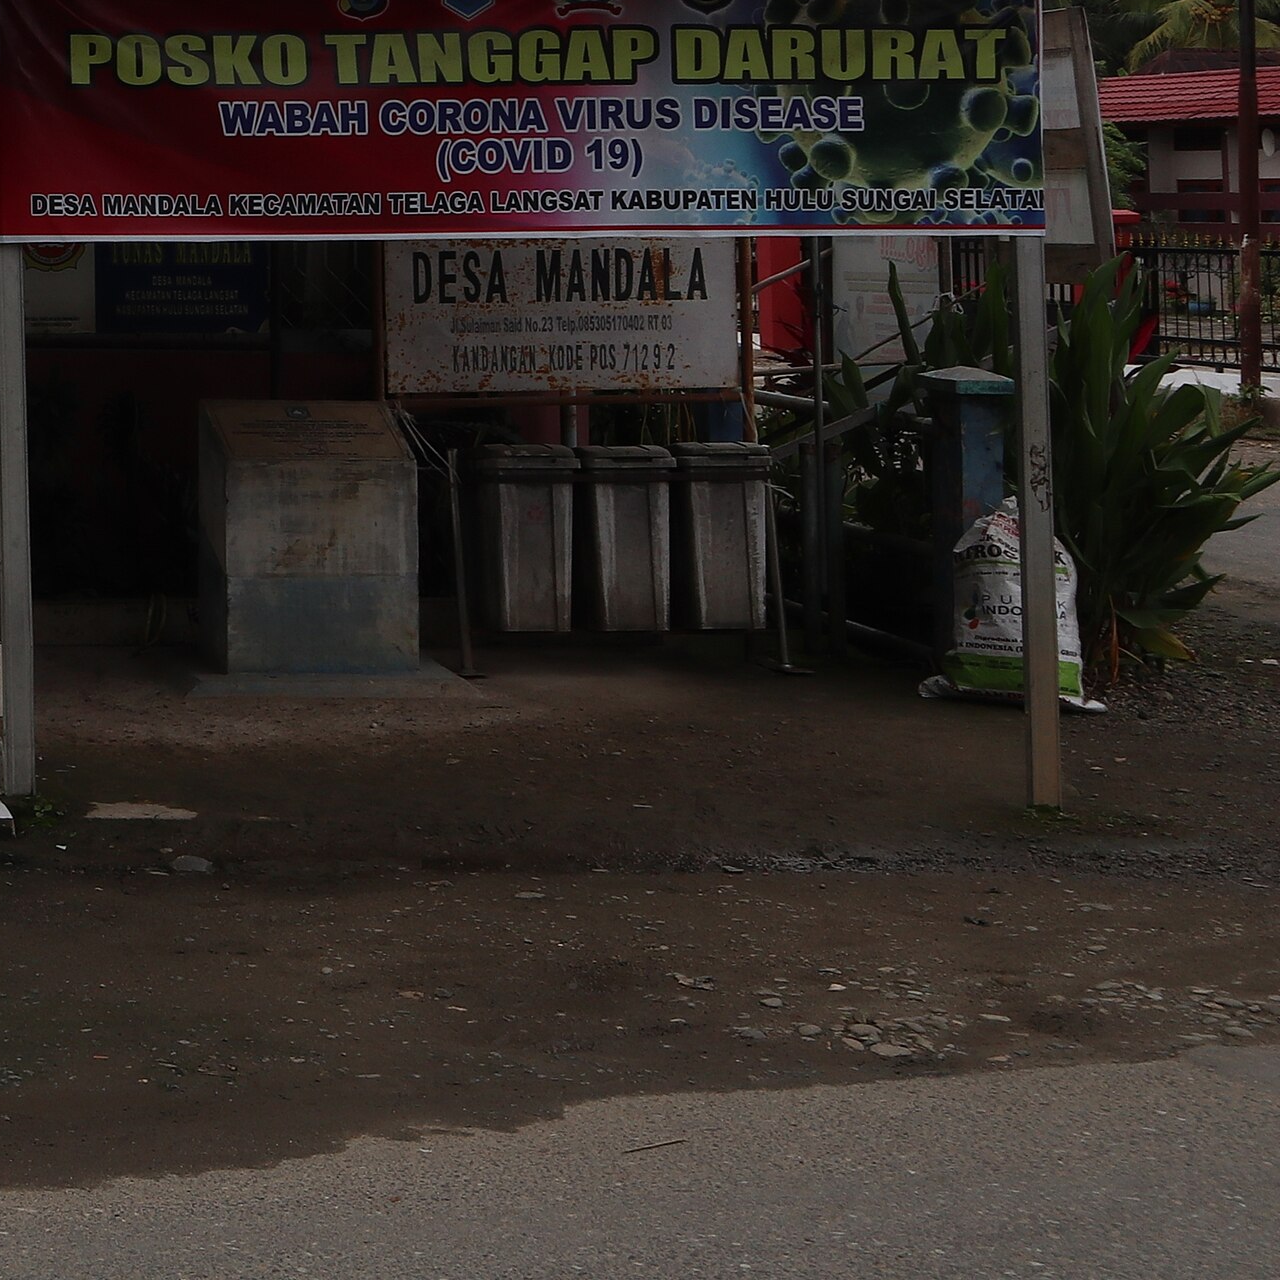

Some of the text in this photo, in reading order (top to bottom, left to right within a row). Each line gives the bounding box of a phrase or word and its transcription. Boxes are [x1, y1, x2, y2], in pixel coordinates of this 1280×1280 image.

[70, 27, 1007, 86] POSKO TANGGAP DARURAT
[219, 95, 864, 136] WABAH CORONA VIRUS DISEASE
[436, 137, 645, 182] (COVID 19)
[30, 194, 97, 216] DESA
[102, 193, 223, 216] MANDALA
[228, 192, 383, 216] KECAMATAN
[387, 191, 485, 215] TELAGA
[490, 190, 604, 214] LANGSAT
[610, 189, 758, 212] KABUPATEN
[765, 188, 834, 211] HULU
[840, 188, 937, 211] SUNGAI
[412, 247, 708, 305] DESA MANDALA
[647, 314, 659, 330] RT
[549, 344, 583, 371] KODE
[590, 343, 616, 370] POS
